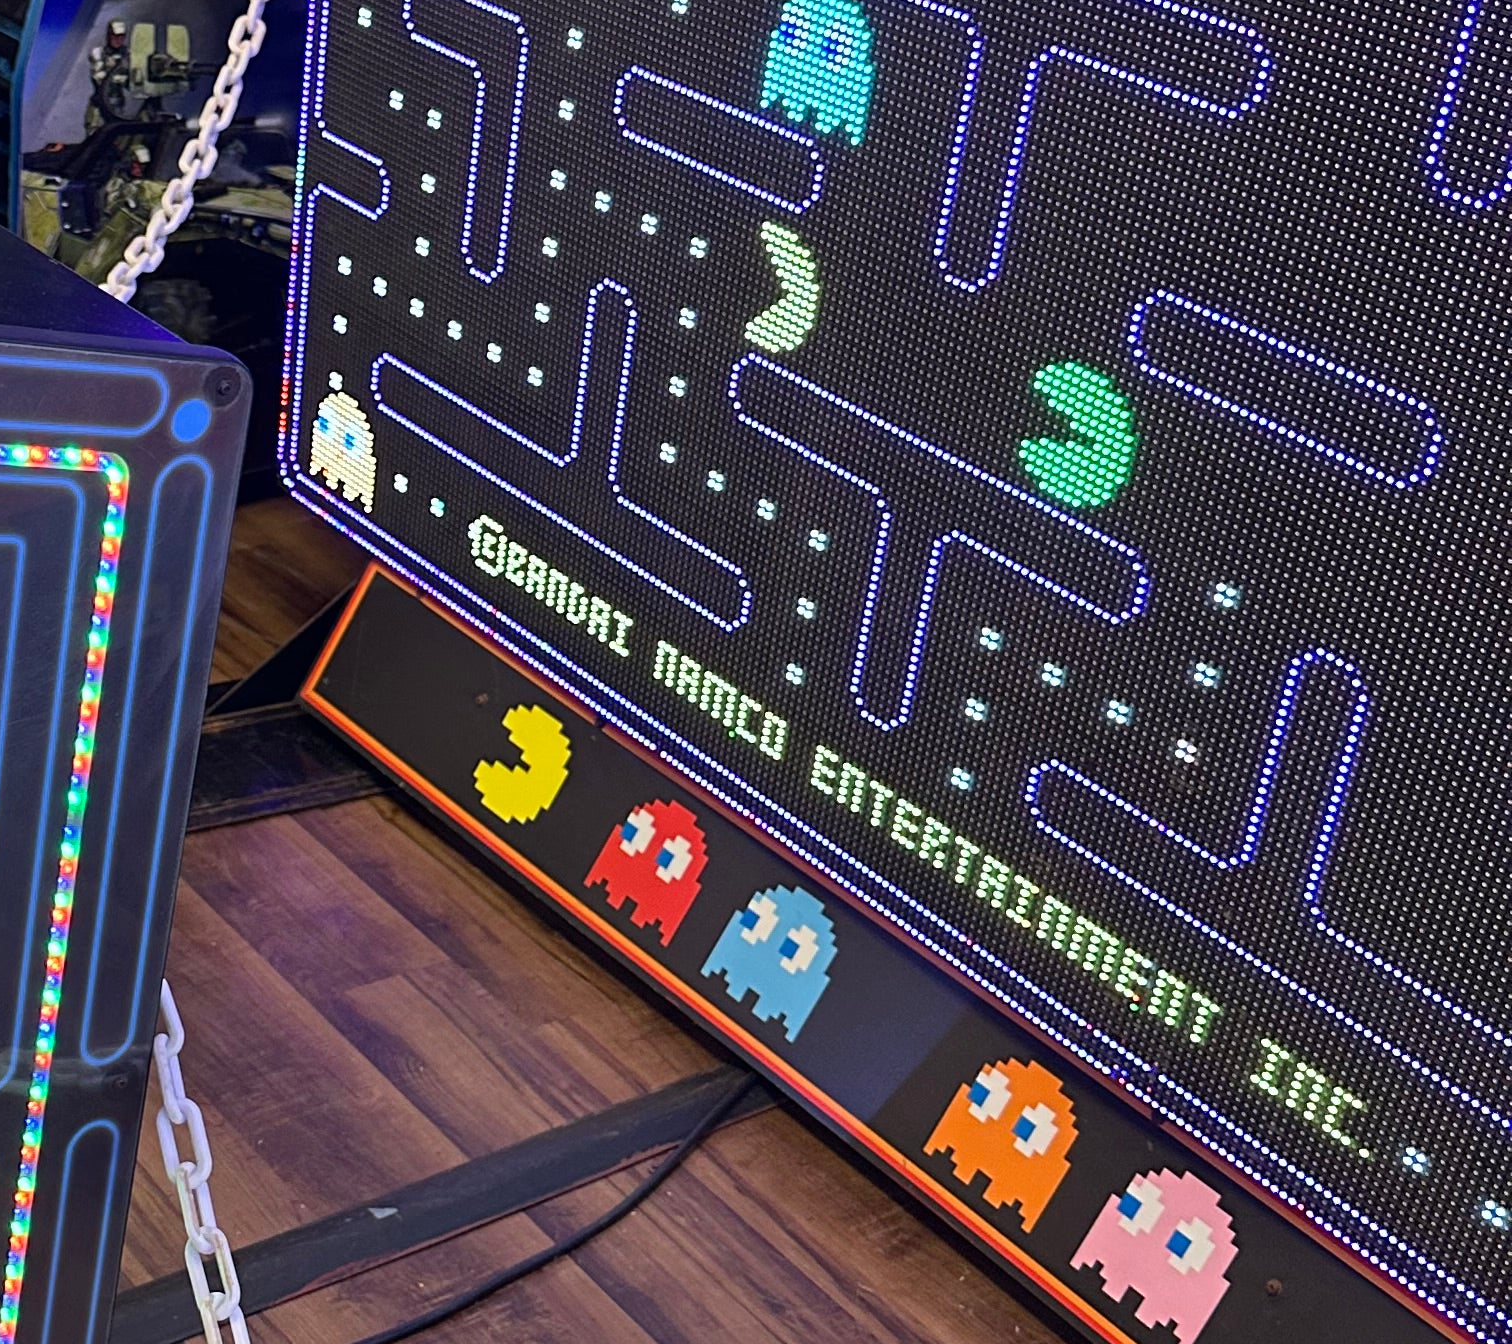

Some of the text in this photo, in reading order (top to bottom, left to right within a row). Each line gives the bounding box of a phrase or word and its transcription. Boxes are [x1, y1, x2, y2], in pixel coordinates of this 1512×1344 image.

[653, 639, 787, 761] NAMCO
[810, 744, 1221, 1044] ENTERTAINMENT
[1250, 1038, 1371, 1158] INC.
